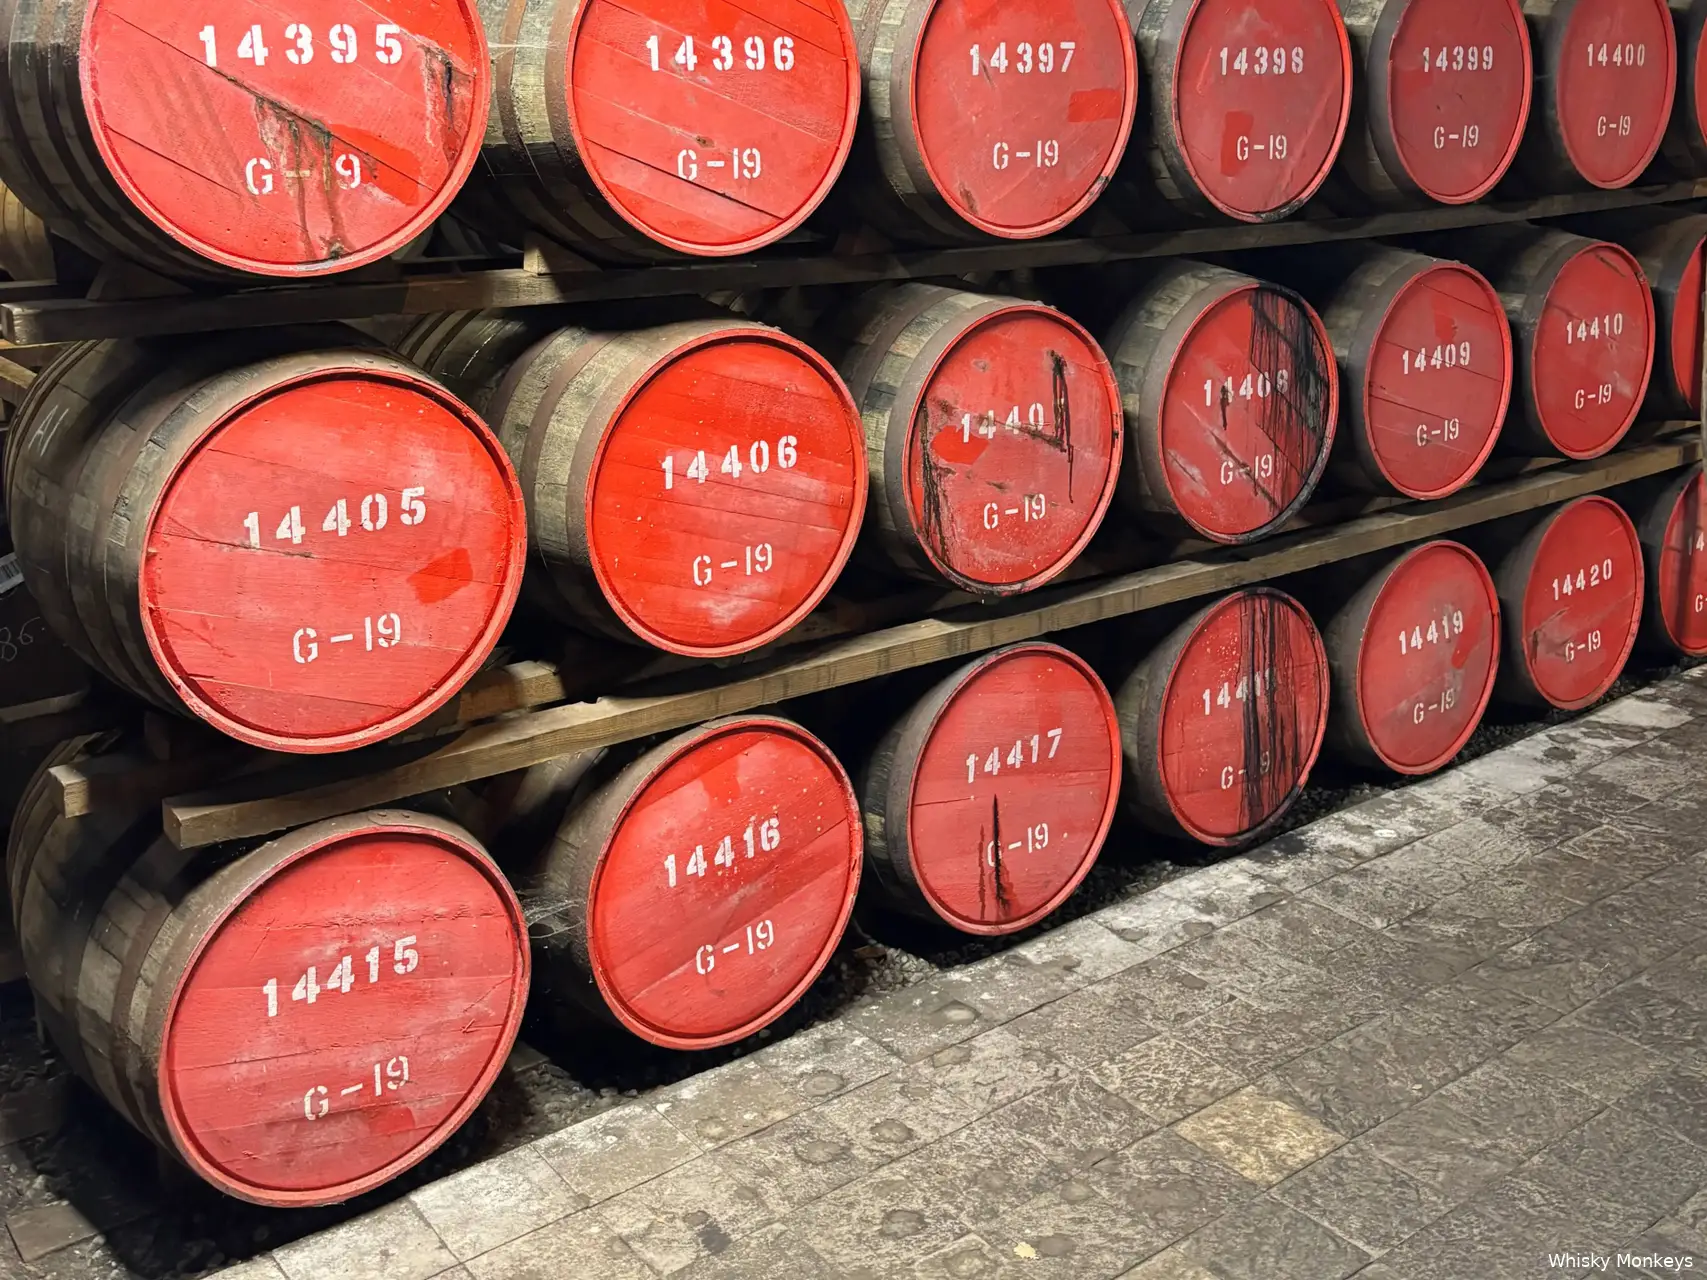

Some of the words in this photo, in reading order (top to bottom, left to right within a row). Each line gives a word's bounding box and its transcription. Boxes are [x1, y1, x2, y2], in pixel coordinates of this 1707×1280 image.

[199, 24, 403, 68] 14395
[646, 35, 795, 72] 14396
[969, 42, 1076, 76] 14397
[1219, 47, 1304, 76] 14398
[1423, 46, 1494, 72] 14399
[1587, 43, 1645, 67] 14400
[1434, 125, 1479, 149] G-19
[1597, 115, 1631, 137] G-19
[677, 147, 761, 181] G-19
[993, 139, 1059, 170] G-19
[1236, 135, 1287, 161] G-19
[1566, 313, 1623, 345] 14410
[1402, 341, 1471, 375] 14409
[1575, 383, 1612, 410] G-19
[1416, 418, 1459, 447] G-19
[661, 435, 798, 490] 14406
[1220, 454, 1273, 485] G-19
[243, 485, 426, 550] 14405
[983, 494, 1046, 530] G-19
[693, 542, 773, 587] G-19
[1552, 558, 1612, 601] 14420
[293, 612, 401, 664] G-19
[1399, 610, 1464, 655] 14419
[1564, 630, 1601, 662] G-19
[1413, 687, 1455, 725] G-19
[966, 728, 1063, 784] 14417
[663, 816, 781, 888] 14416
[695, 919, 774, 976] G-19
[262, 936, 419, 1018] 14415
[304, 1055, 411, 1121] G-19
